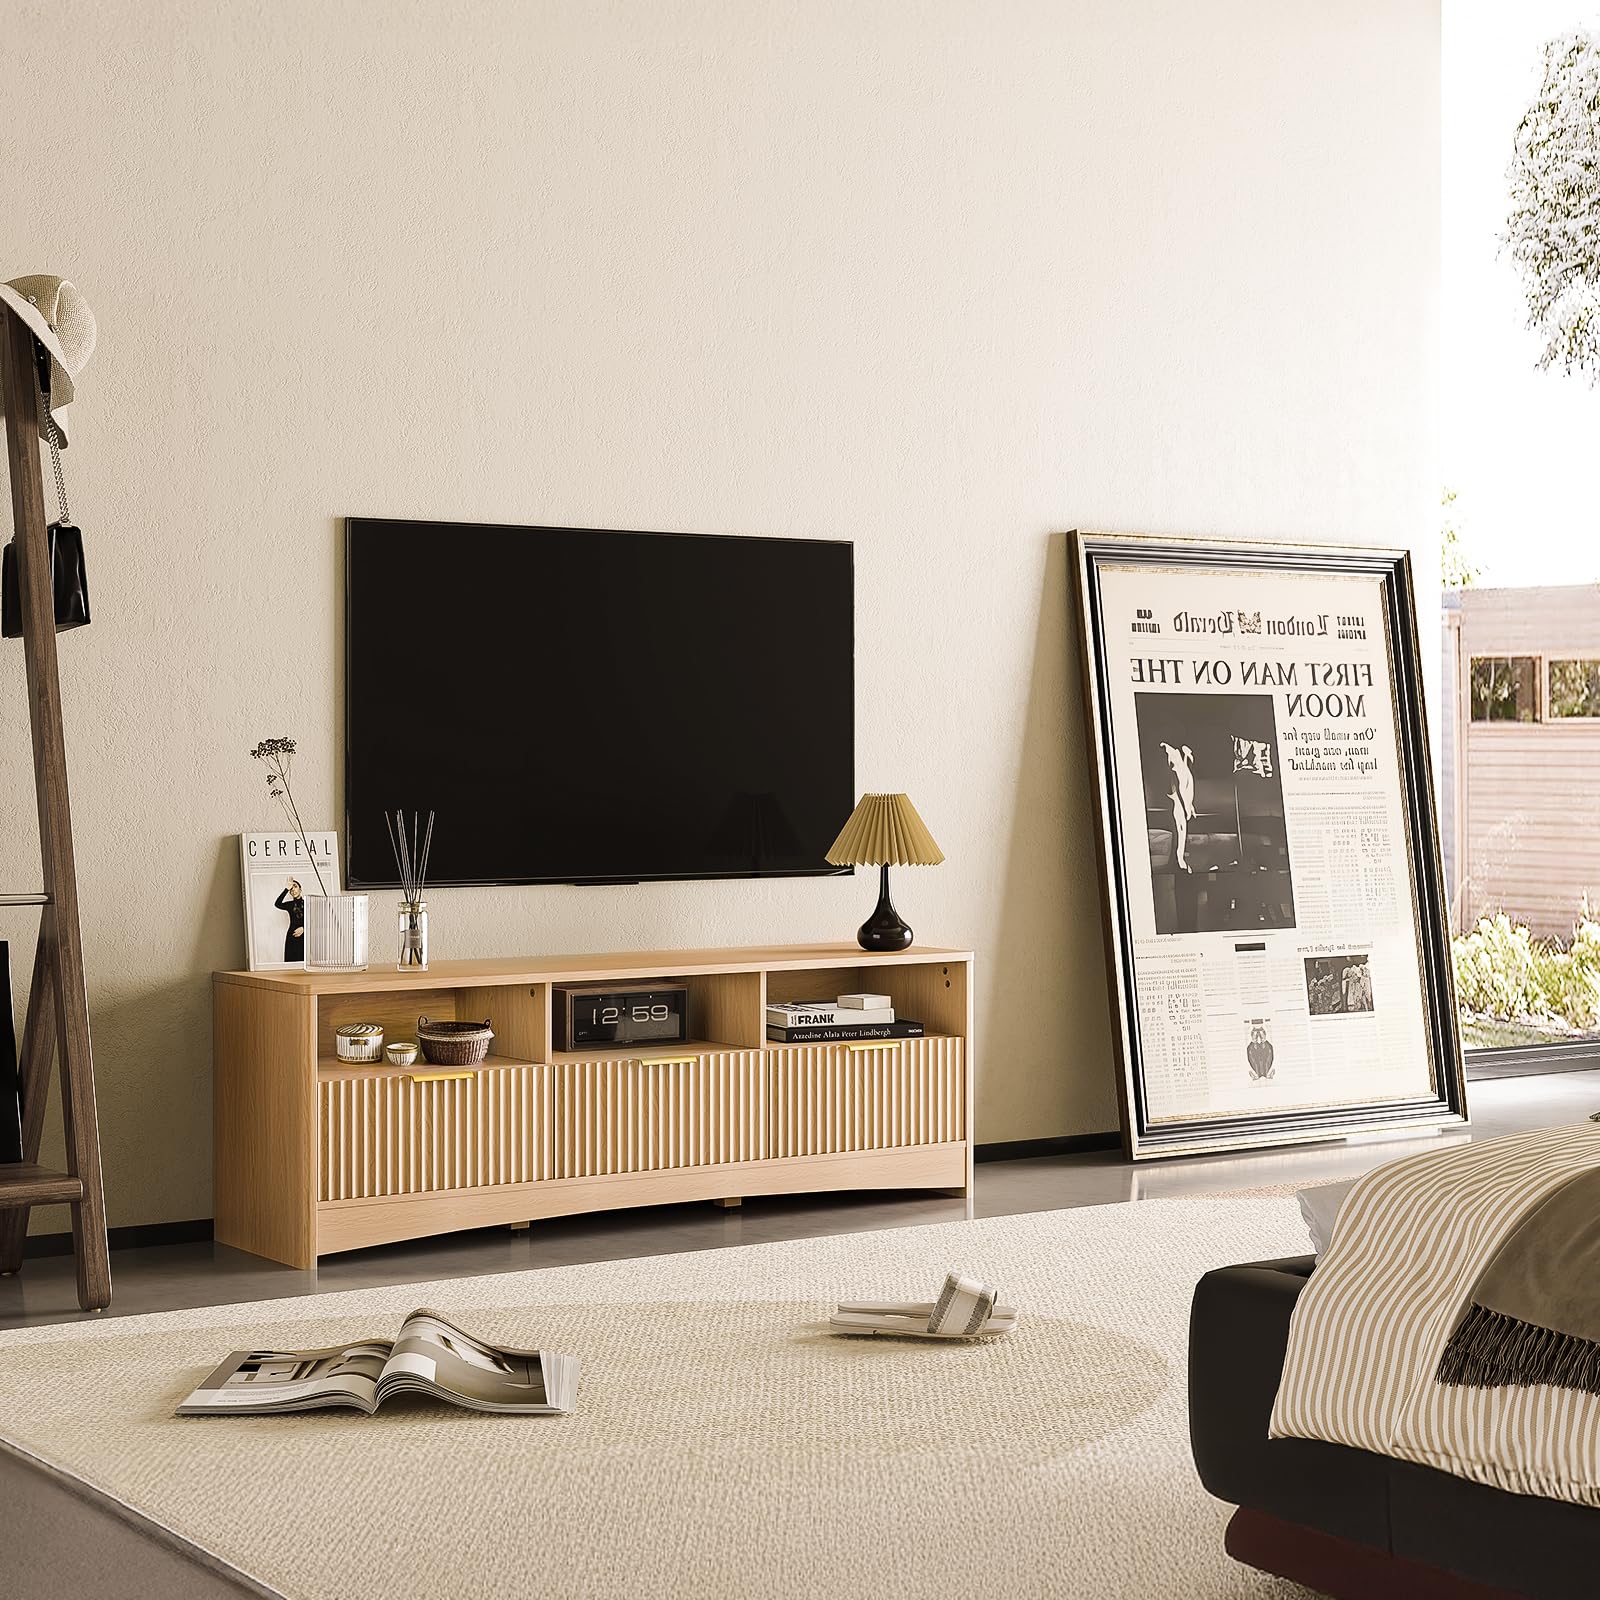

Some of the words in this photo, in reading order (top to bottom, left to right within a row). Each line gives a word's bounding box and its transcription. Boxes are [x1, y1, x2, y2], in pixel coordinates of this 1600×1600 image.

[248, 839, 332, 857] CEREAL
[798, 1013, 835, 1025] FRANK
[859, 1028, 891, 1038] Lindbergh
